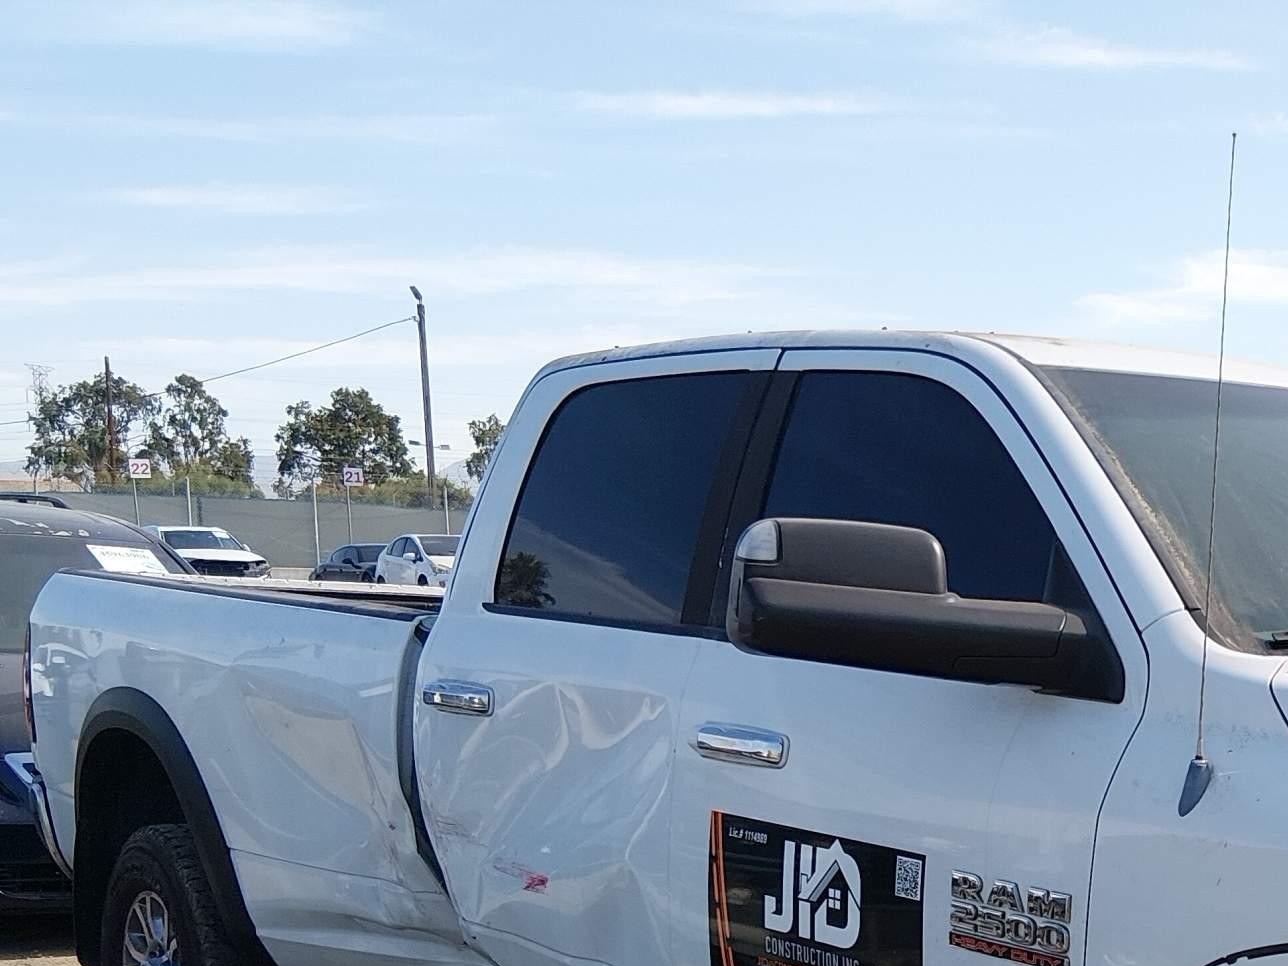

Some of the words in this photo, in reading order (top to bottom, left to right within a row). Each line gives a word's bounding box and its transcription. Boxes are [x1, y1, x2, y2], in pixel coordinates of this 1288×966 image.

[131, 463, 150, 475] 22
[345, 471, 363, 483] 21
[951, 869, 1072, 923] RAM
[950, 900, 1071, 954] 2500
[951, 934, 1008, 957] HEAVY
